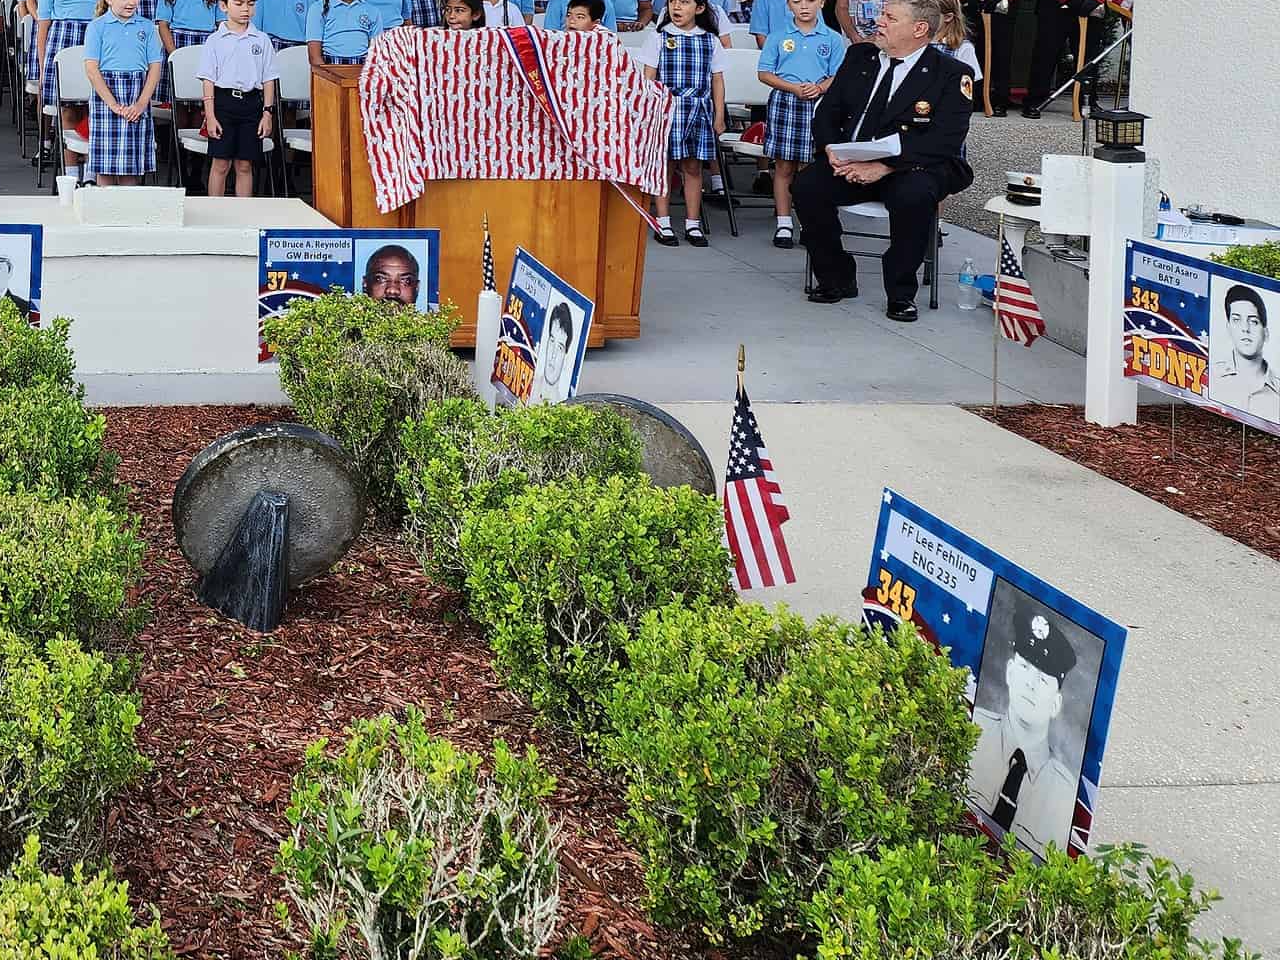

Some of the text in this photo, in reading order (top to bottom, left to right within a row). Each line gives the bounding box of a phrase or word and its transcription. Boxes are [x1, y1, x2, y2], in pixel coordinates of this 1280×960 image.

[269, 240, 350, 250] PO Bruce A. Reynolds
[286, 251, 333, 262] GW Bridge
[267, 271, 288, 290] 37
[1142, 256, 1198, 280] FF Carol Asaro
[1158, 272, 1181, 286] BAT 9
[508, 294, 524, 321] 343
[1132, 286, 1160, 313] 343
[496, 342, 535, 407] FDNY
[1132, 335, 1207, 396] FDNY
[901, 521, 977, 582] FF Lee Fehling
[912, 551, 958, 589] ENG 235
[876, 568, 917, 620] 343
